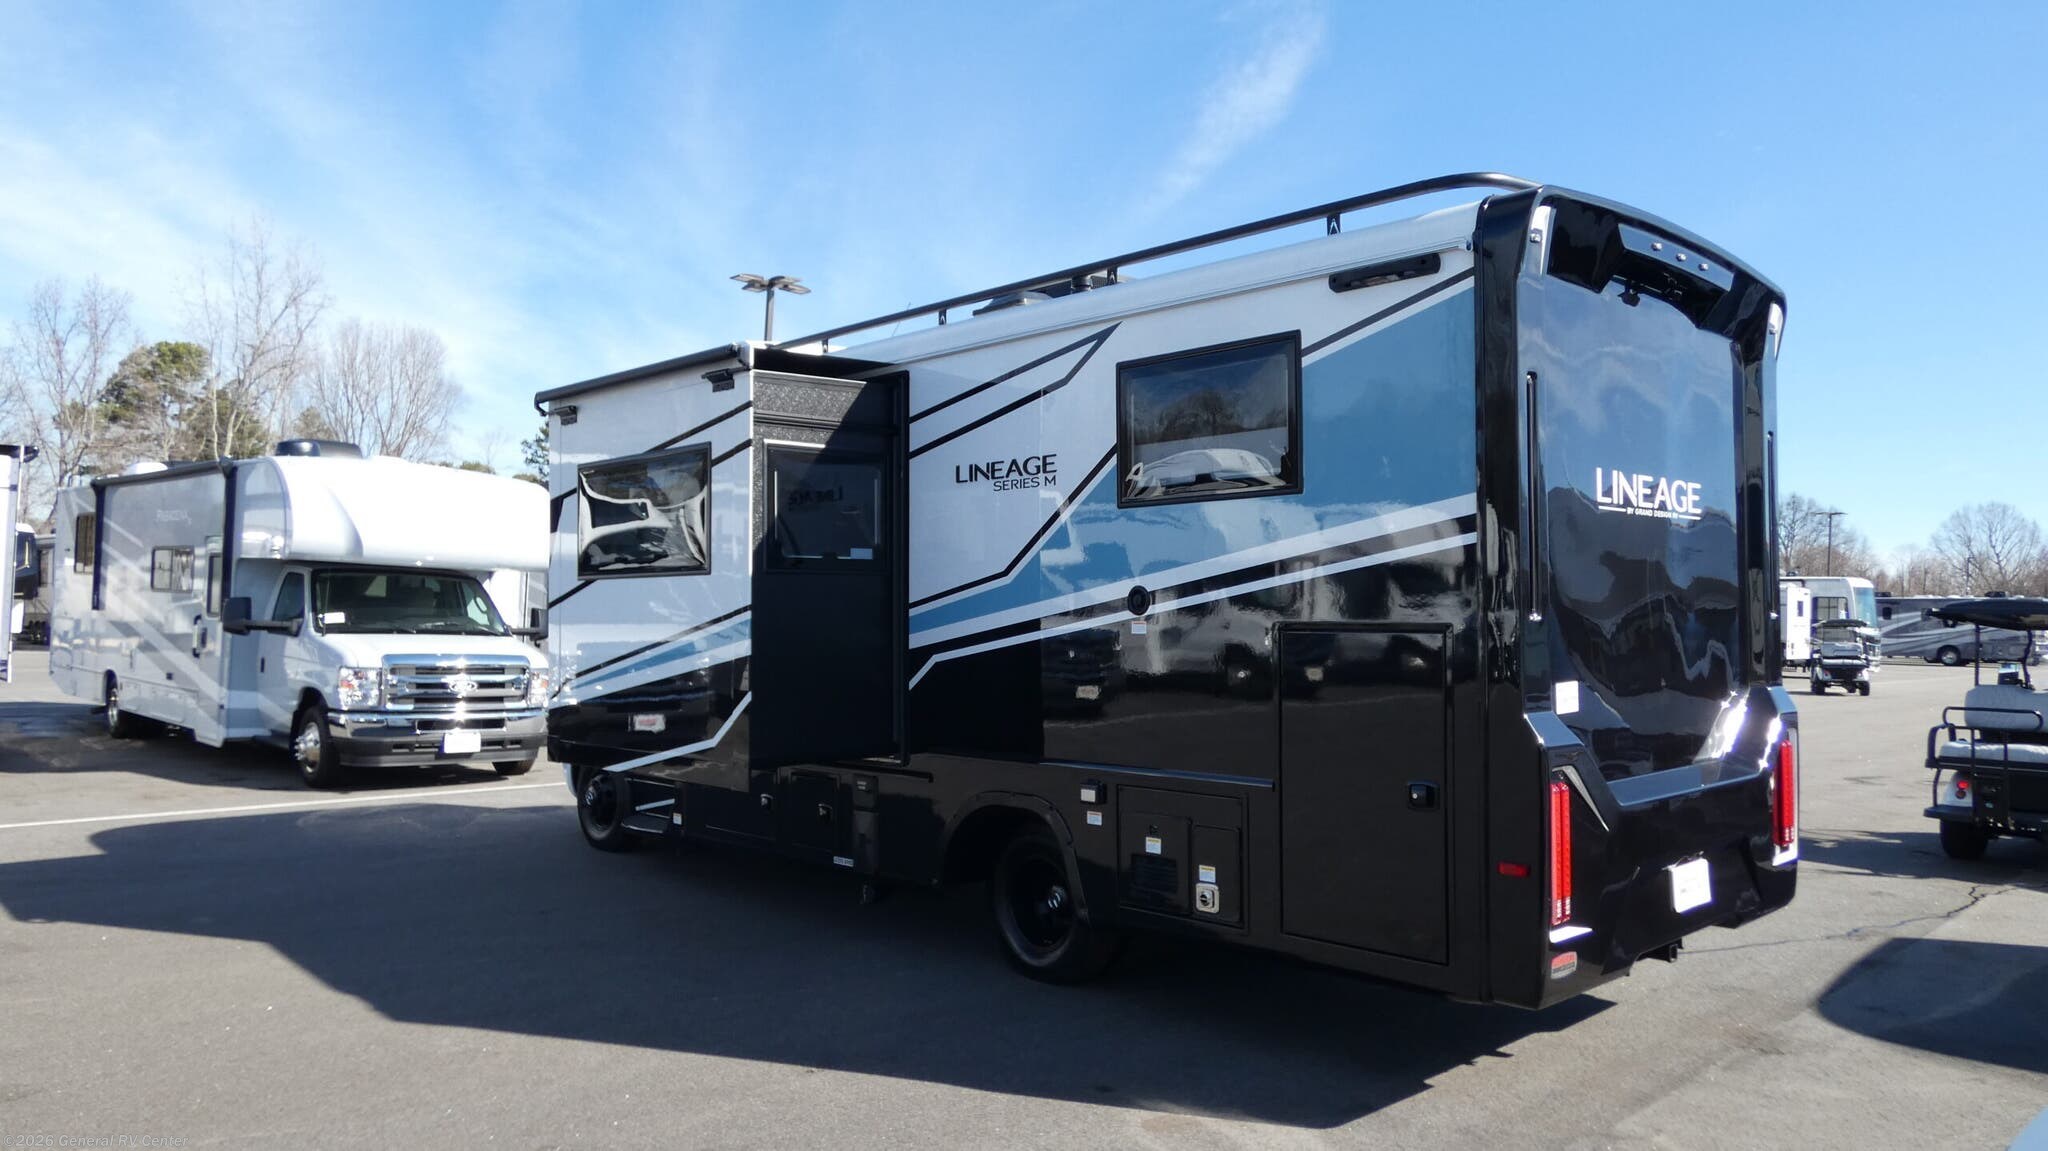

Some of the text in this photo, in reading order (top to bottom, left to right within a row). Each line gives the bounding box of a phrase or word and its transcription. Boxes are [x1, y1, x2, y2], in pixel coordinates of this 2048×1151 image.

[956, 454, 1057, 484] LINEAGE
[993, 475, 1057, 492] SERIES M
[1596, 467, 1702, 514] LINEAGE
[1627, 507, 1634, 515] BY
[1634, 508, 1653, 517] GRAND
